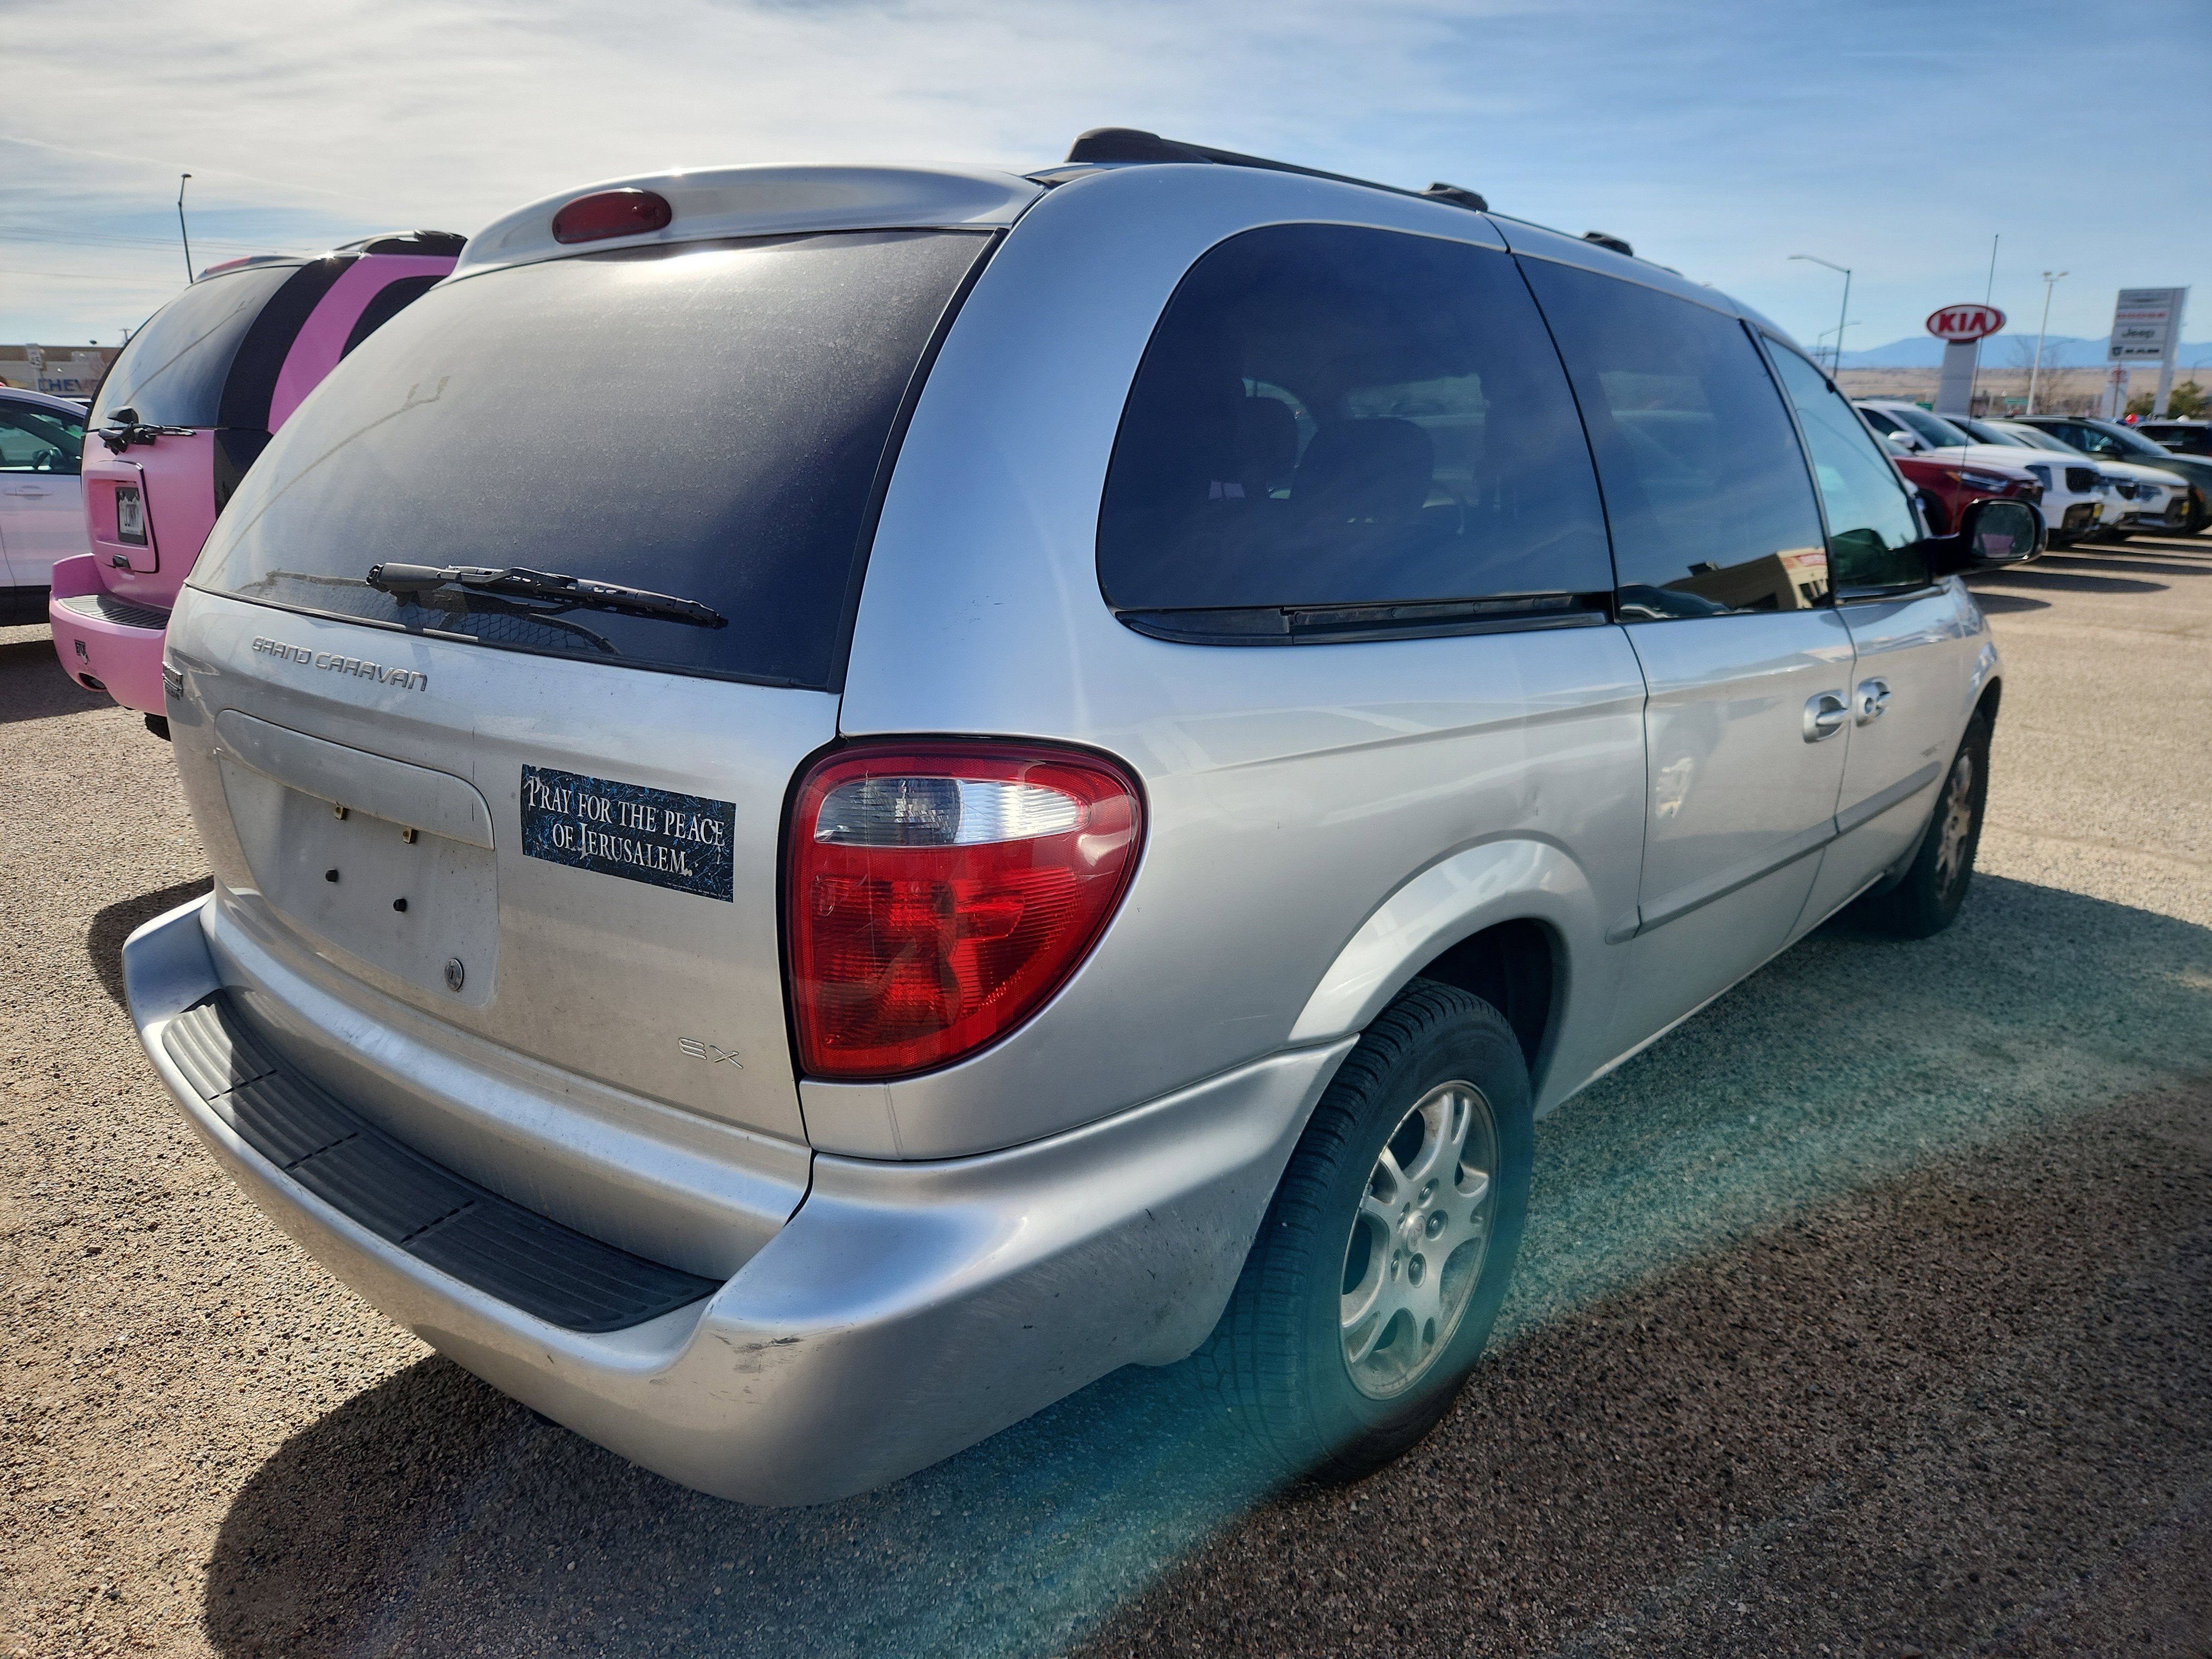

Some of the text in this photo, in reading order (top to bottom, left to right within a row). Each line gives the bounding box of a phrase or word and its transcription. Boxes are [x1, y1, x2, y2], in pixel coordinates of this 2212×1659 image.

[1937, 312, 1986, 333] KIA
[252, 635, 428, 692] GRAND CARAVAN
[527, 775, 725, 846] PRAY FOR THE PEACE
[552, 823, 575, 851] OF
[678, 1037, 743, 1069] EX
